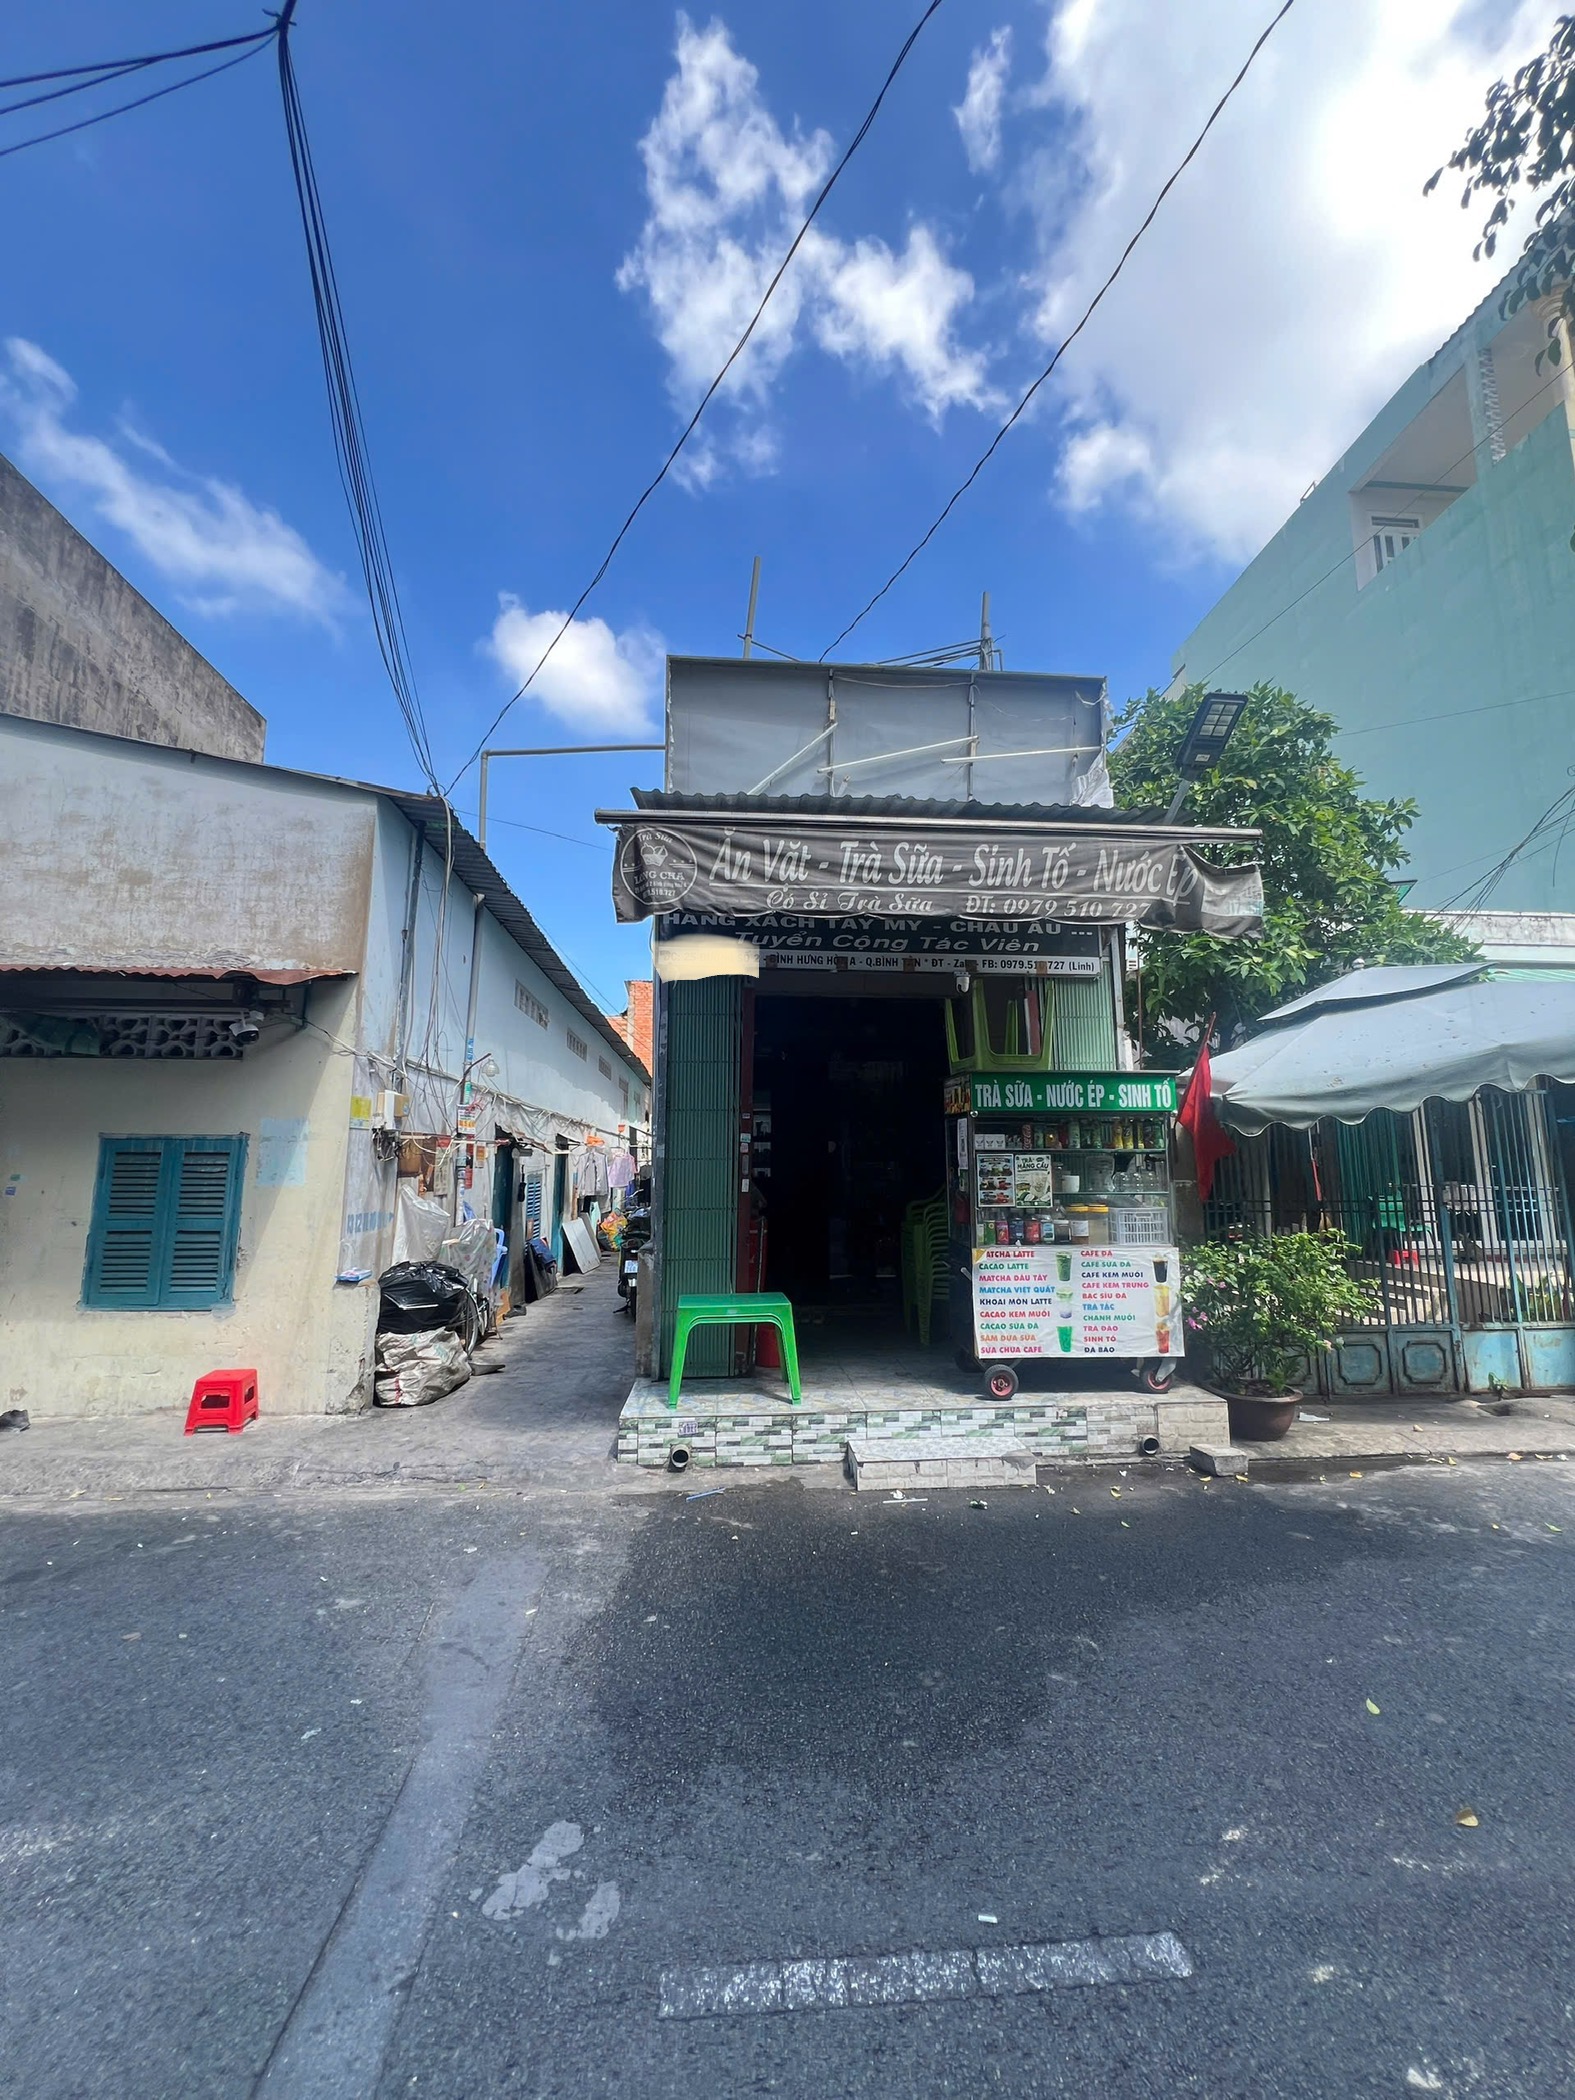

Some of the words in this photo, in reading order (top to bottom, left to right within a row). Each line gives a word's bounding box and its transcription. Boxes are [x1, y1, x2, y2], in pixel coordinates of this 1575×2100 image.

[709, 827, 753, 882] Ăn
[763, 838, 812, 892] Vặt
[839, 840, 882, 884] Trà
[888, 841, 944, 885] Sữa
[968, 843, 1033, 888] Sinh
[1041, 842, 1077, 890] Tố
[1093, 849, 1163, 893] Nước
[766, 890, 794, 910] Có
[837, 891, 883, 912] Trà
[888, 892, 935, 912] Sữa
[965, 895, 996, 914] ĐT:
[1003, 899, 1058, 918] 0979
[1064, 900, 1102, 918] 510
[1110, 901, 1151, 919] 727
[825, 918, 877, 930] TAY
[735, 930, 822, 948] Tuyển
[832, 933, 907, 951] Cộng
[920, 936, 969, 951] Tác
[980, 938, 1040, 952] Viên
[1069, 962, 1095, 971] (Linh)
[975, 1080, 1001, 1107] TRÀ
[1005, 1080, 1033, 1107] SỮA
[1046, 1079, 1083, 1107] NƯỚC
[1088, 1076, 1105, 1108] ÉP
[1118, 1084, 1151, 1108] SINH
[1154, 1076, 1172, 1108] TỐ
